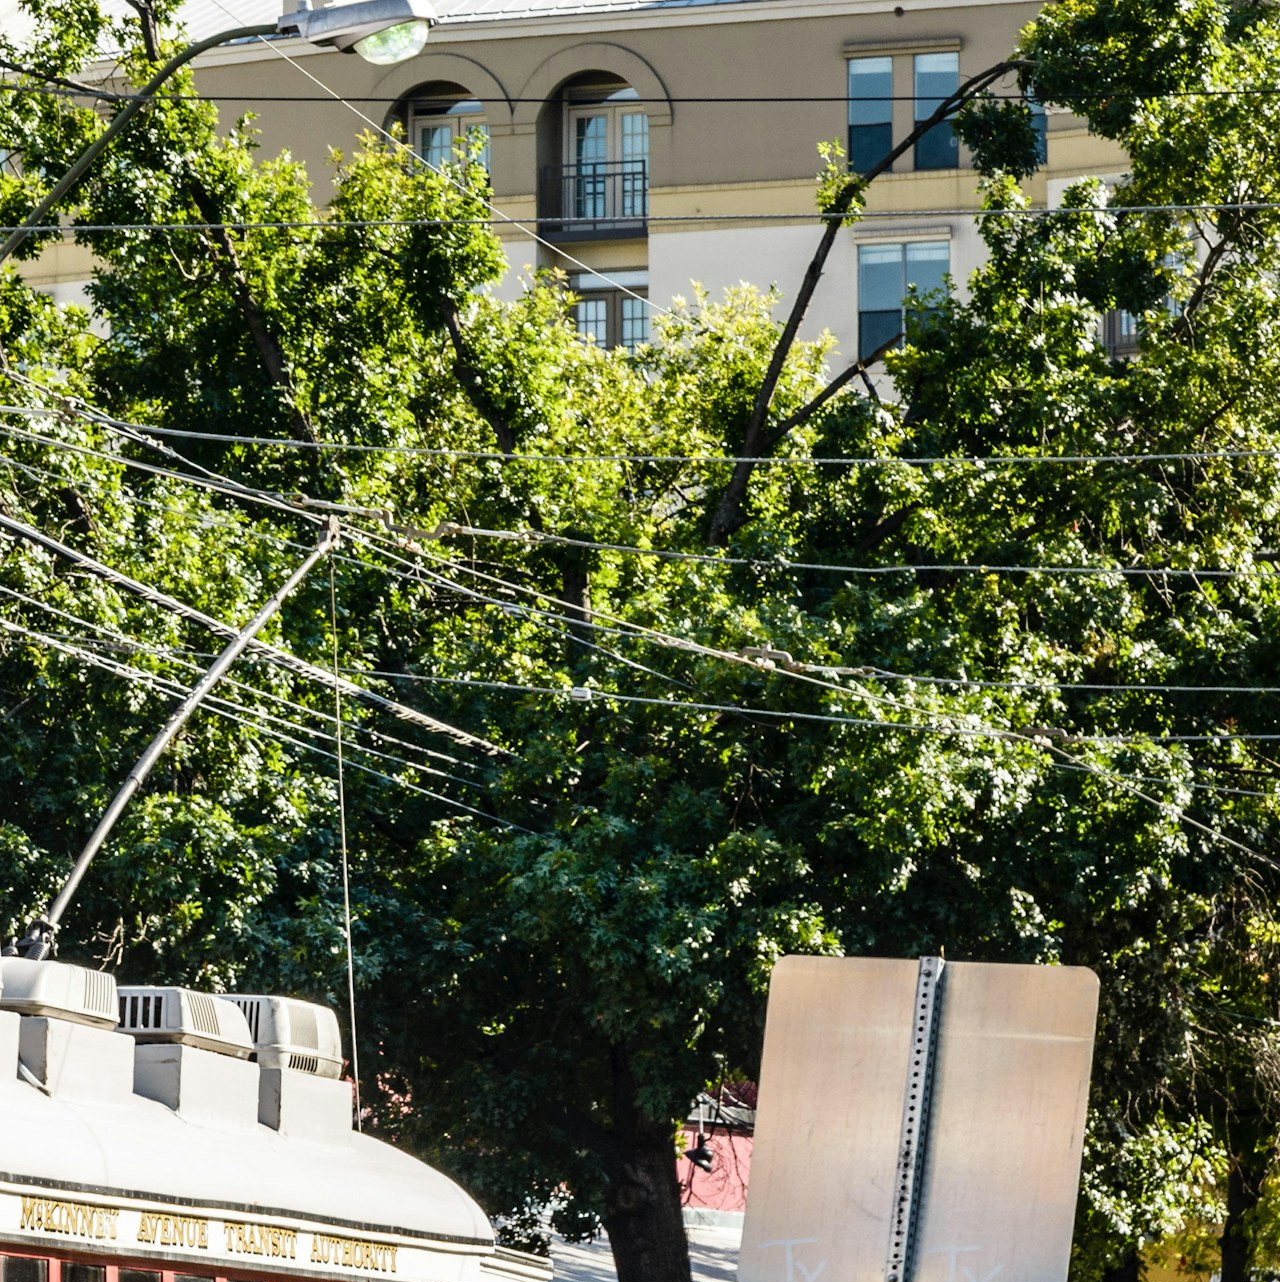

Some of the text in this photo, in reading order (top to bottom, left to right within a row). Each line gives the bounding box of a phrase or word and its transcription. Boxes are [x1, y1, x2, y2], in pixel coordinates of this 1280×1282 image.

[137, 1211, 209, 1250] AVENUE
[224, 1220, 298, 1260] TRANSIT
[310, 1233, 399, 1273] AUTHORITY
